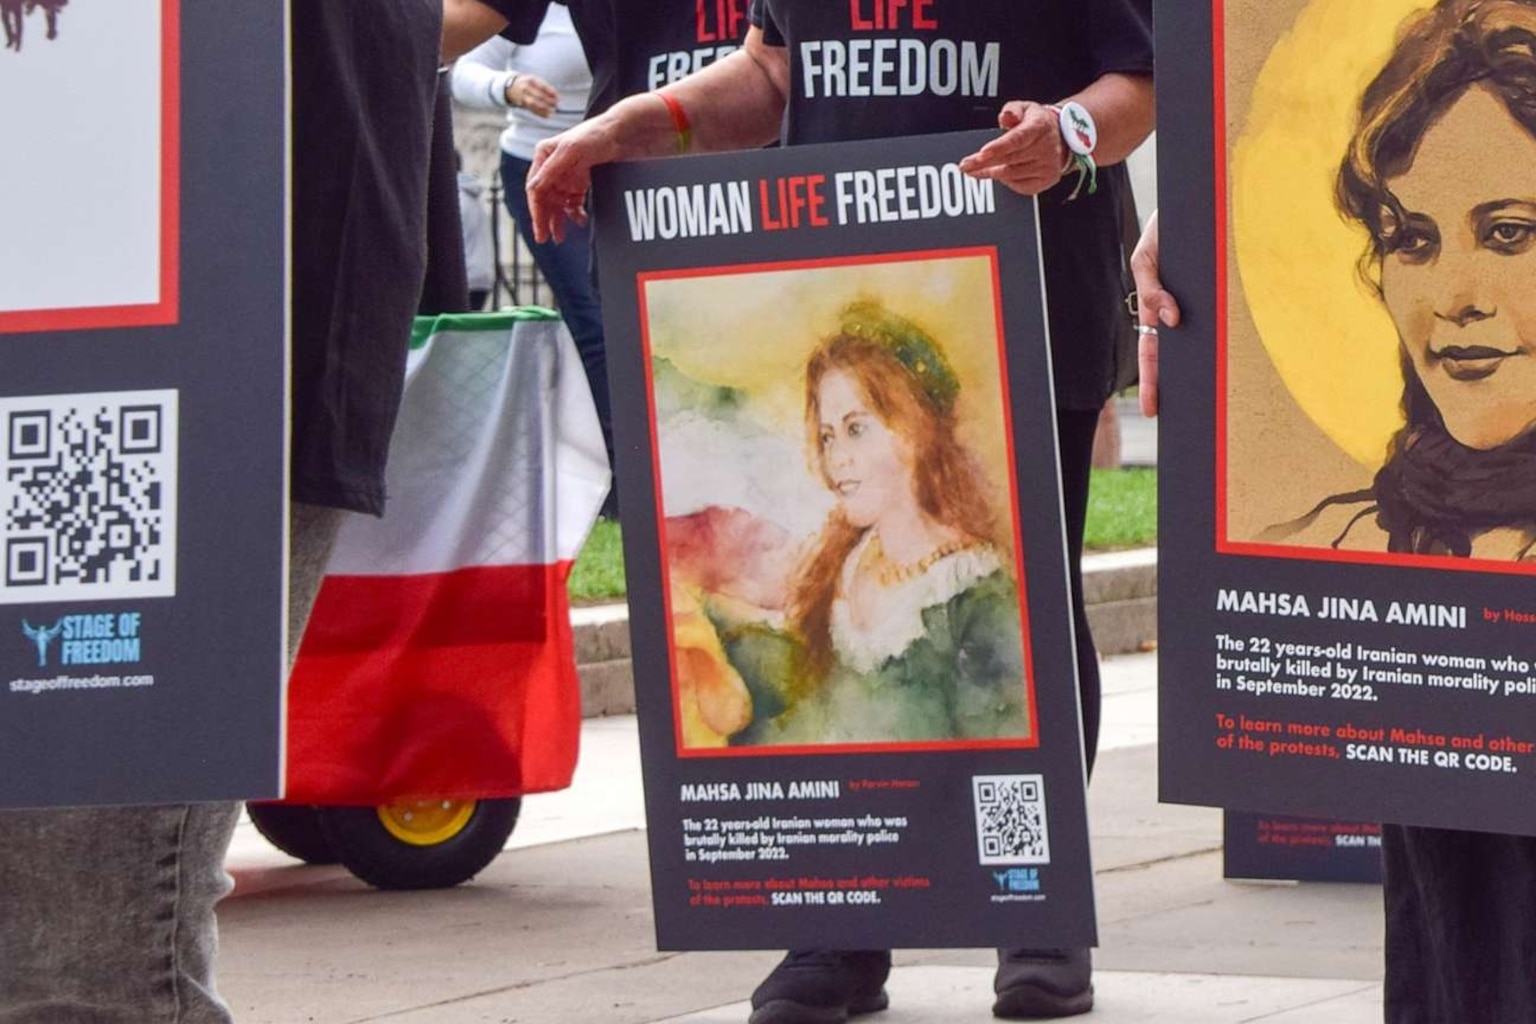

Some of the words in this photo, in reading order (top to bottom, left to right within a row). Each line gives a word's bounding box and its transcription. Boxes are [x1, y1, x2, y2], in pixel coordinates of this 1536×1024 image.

[800, 38, 1000, 99] FREEDOM
[624, 180, 752, 242] WOMAN
[759, 175, 829, 231] LIFE
[835, 162, 995, 226] FREEDOM
[1216, 589, 1310, 617] MAHSA
[1317, 596, 1378, 622] JINA
[1385, 601, 1466, 629] AMINI
[1483, 607, 1500, 623] by
[62, 614, 115, 640] STAGE
[118, 612, 141, 637] OF
[61, 638, 141, 665] FREEDOM
[1215, 634, 1244, 652] The
[1249, 637, 1271, 654] 22
[1275, 642, 1352, 660] years-old
[1357, 645, 1417, 665] Iranian
[1422, 653, 1486, 670] woman
[1491, 655, 1529, 674] who
[9, 674, 154, 694] stageoffreedom.com
[1216, 653, 1281, 677] brutally
[1286, 658, 1331, 678] killed
[1336, 662, 1358, 684] by
[1363, 665, 1423, 685] Iranian
[1427, 672, 1499, 695] morality
[1216, 673, 1231, 690] in
[1236, 675, 1326, 697] September
[1330, 683, 1378, 702] 2022.
[1216, 713, 1235, 729] To
[1240, 715, 1282, 733] learn
[1287, 721, 1331, 737] more
[1336, 724, 1385, 742] about
[1390, 728, 1445, 747] Mahsa
[1451, 733, 1484, 750] and
[1488, 736, 1535, 754] other
[1216, 734, 1233, 749] of
[1239, 734, 1264, 751] the
[1270, 741, 1340, 759] protests,
[1346, 744, 1393, 763] SCAN
[1397, 748, 1429, 766] THE
[1434, 750, 1460, 768] QR
[1465, 753, 1517, 773] CODE.
[681, 783, 741, 802] MAHSA
[745, 782, 784, 800] JINA
[788, 780, 840, 799] AMINI
[683, 818, 702, 831] The
[703, 818, 719, 831] 22
[772, 816, 811, 830] Iranian
[813, 818, 855, 828] woman
[857, 814, 882, 828] who
[884, 817, 908, 828] was
[684, 833, 726, 849] brutally
[728, 832, 758, 846] killed
[760, 832, 775, 847] by
[777, 831, 816, 845] Iranian
[818, 830, 864, 846] morality
[866, 829, 899, 846] police
[1335, 834, 1365, 847] SCAN
[685, 848, 696, 861] in
[698, 847, 756, 864] September
[757, 847, 790, 860] 2022.
[772, 892, 803, 905] SCAN
[804, 891, 825, 904] THE
[827, 890, 844, 904] QR
[846, 890, 881, 904] CODE.
